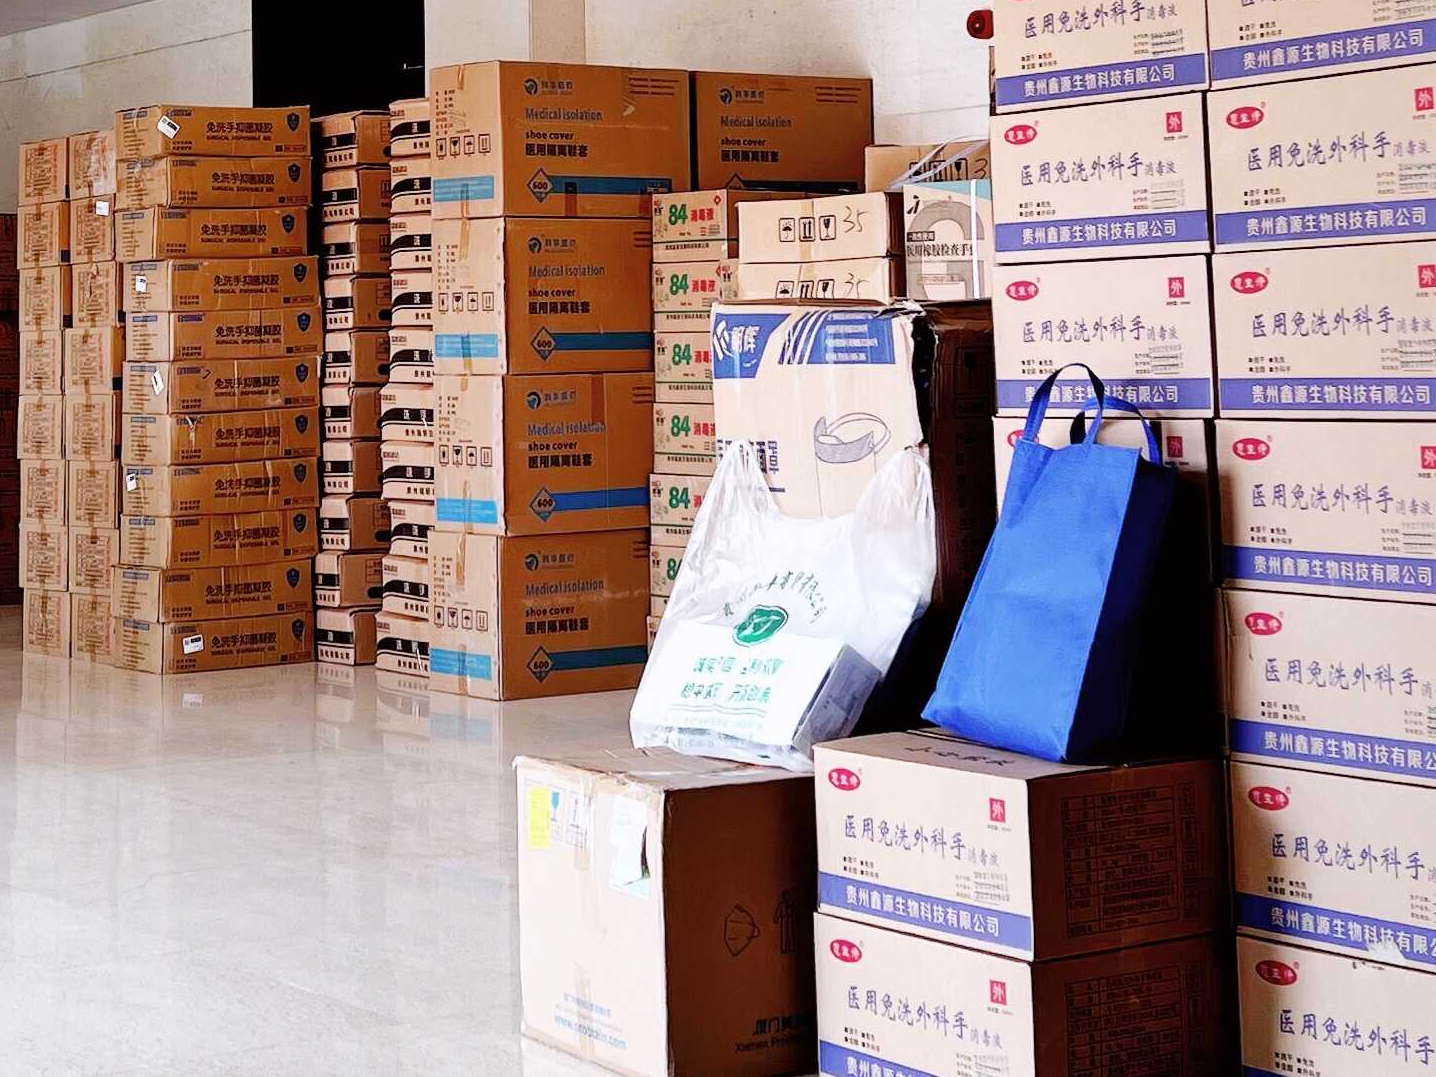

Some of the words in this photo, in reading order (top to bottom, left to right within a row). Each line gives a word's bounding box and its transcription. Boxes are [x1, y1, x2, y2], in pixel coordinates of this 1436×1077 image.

[1243, 27, 1424, 70] 贵州鑫源生物科技有限公司
[1024, 63, 1175, 98] 贵州鑫源生物科技有限公司
[525, 108, 562, 121] Medical
[563, 108, 602, 121] isolation
[525, 130, 547, 140] shoe
[549, 131, 574, 140] cover
[1248, 131, 1430, 172] 医用免洗外科手消毒液
[1021, 151, 1177, 186] 医用免洗外科手消毒液
[669, 203, 688, 226] 84
[843, 204, 872, 235] 35
[1246, 206, 1427, 237] 贵州鑫源生物科技有限公司
[1022, 219, 1177, 245] 贵州鑫源生物科技有限公司
[529, 265, 565, 277] Medical
[565, 264, 605, 276] isolation
[528, 288, 550, 298] shoe
[552, 289, 576, 297] cover
[670, 273, 689, 296] 84
[1023, 315, 1179, 343] 医用免洗外科手消毒液
[1252, 304, 1434, 338] 医用免洗外科手消毒液
[672, 343, 692, 365] 84
[1252, 385, 1431, 405] 贵州鑫源生物科技有限公司
[671, 415, 691, 437] 84
[669, 486, 690, 509] 84
[1252, 483, 1433, 515] 医用免洗外科手消毒液
[1253, 555, 1433, 586] 贵州鑫源生物科技有限公司
[526, 582, 562, 596] Medical
[563, 579, 604, 593] isolation
[525, 606, 548, 616] shoe
[549, 604, 574, 615] cover
[844, 815, 999, 868] 医用免洗外科手消毒液
[845, 884, 1000, 938] 贵州鑫源生物科技有限公司
[848, 986, 1003, 1050] 医用免洗外科手消毒液
